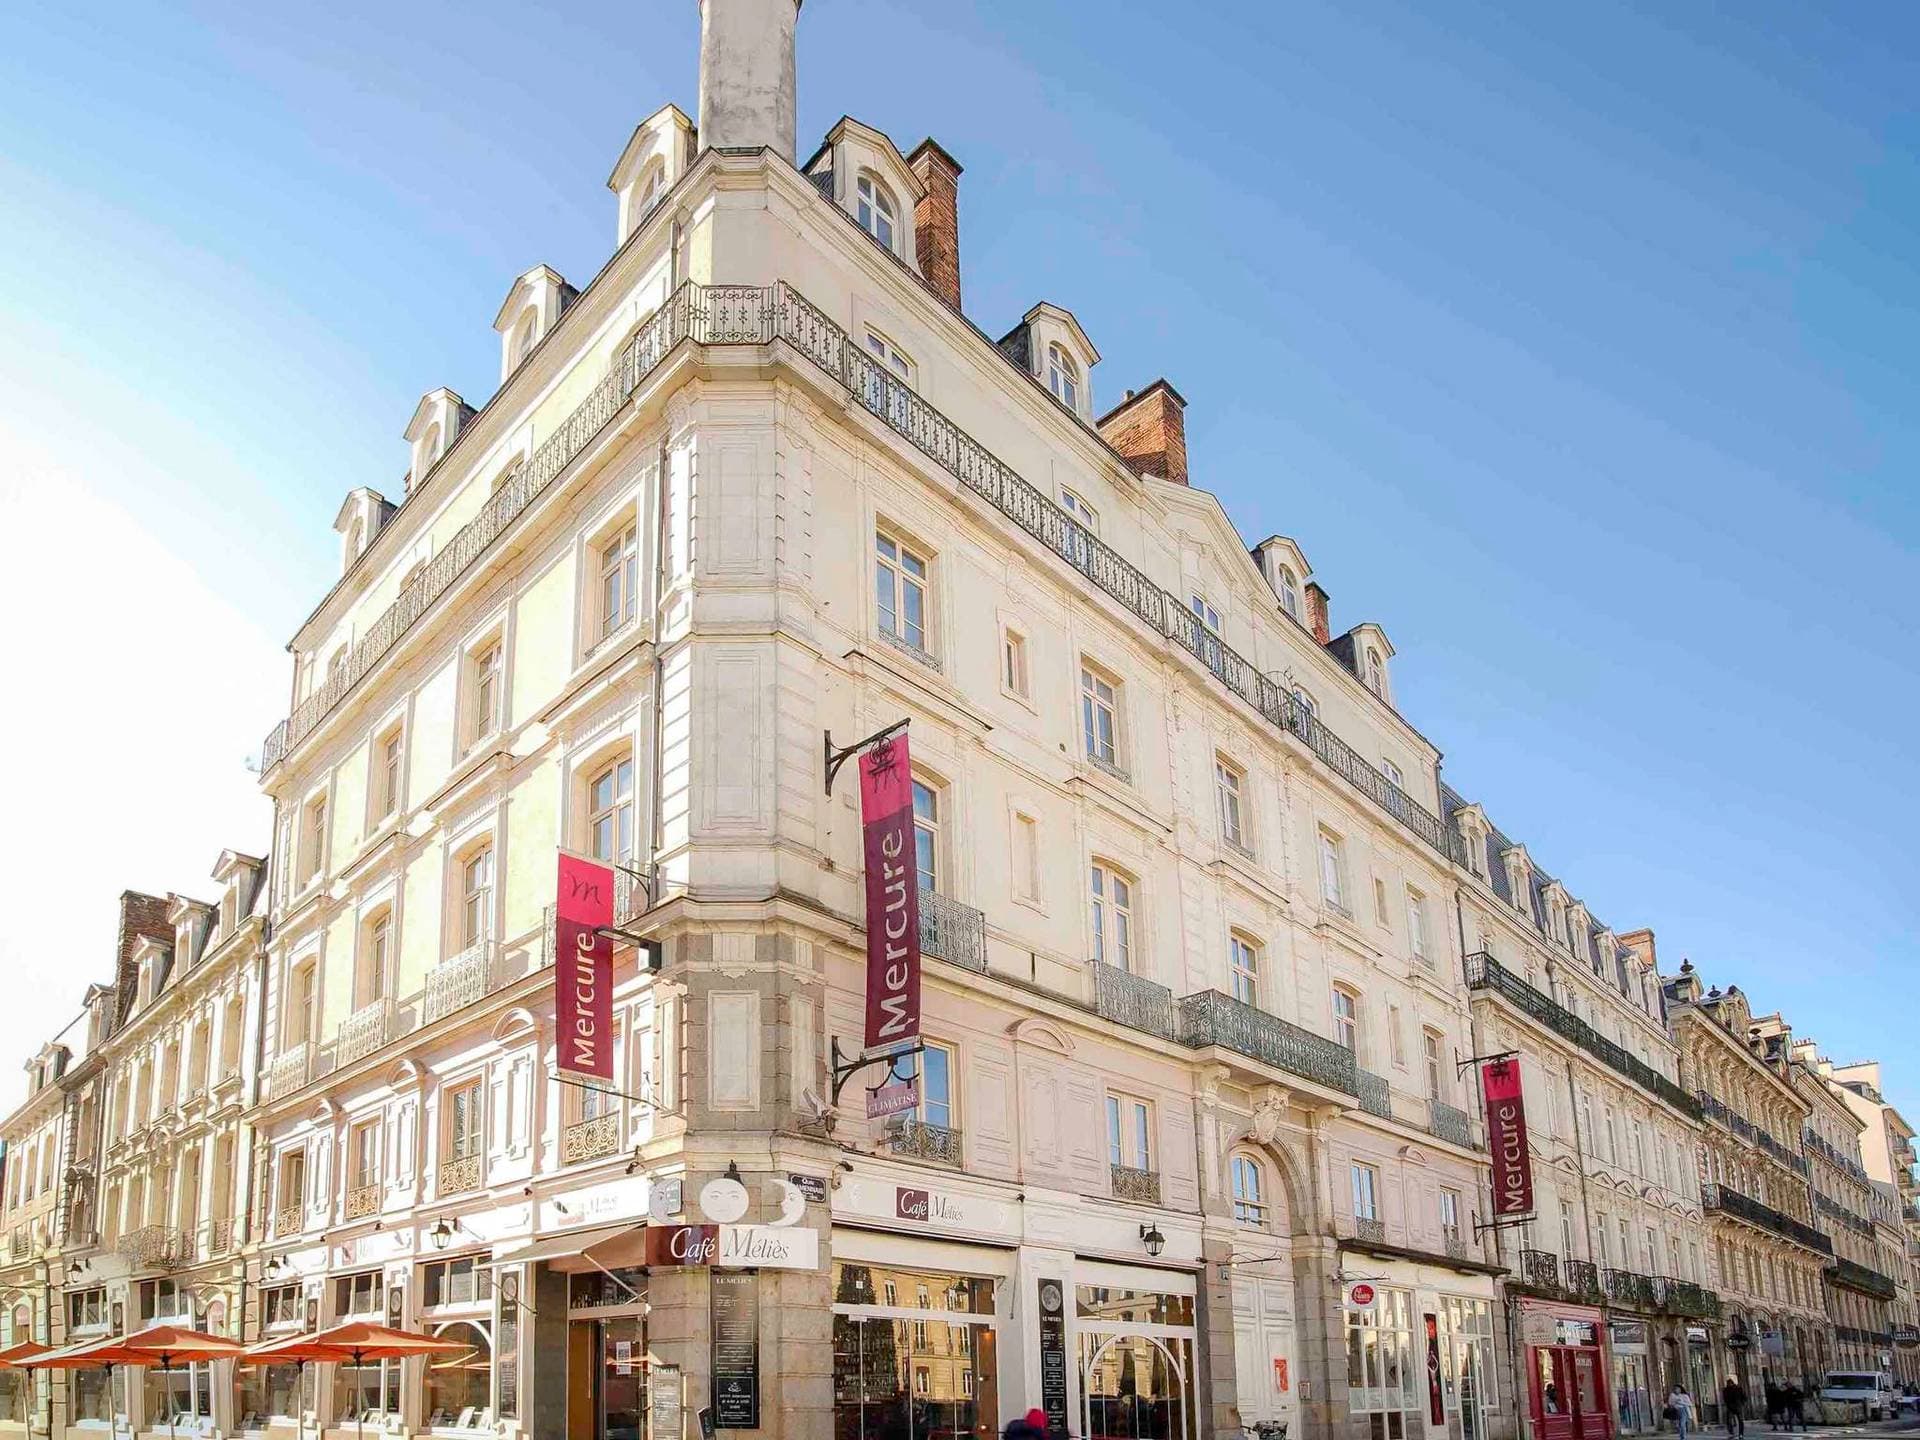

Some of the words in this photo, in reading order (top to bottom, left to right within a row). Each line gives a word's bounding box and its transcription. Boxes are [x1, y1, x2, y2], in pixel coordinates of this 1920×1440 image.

[878, 828, 908, 1038] Mercure
[573, 931, 596, 1067] Mercure
[900, 1190, 928, 1219] Café
[1499, 1104, 1524, 1212] Mercure
[670, 1227, 716, 1264] Café
[723, 1228, 790, 1260] Méliès
